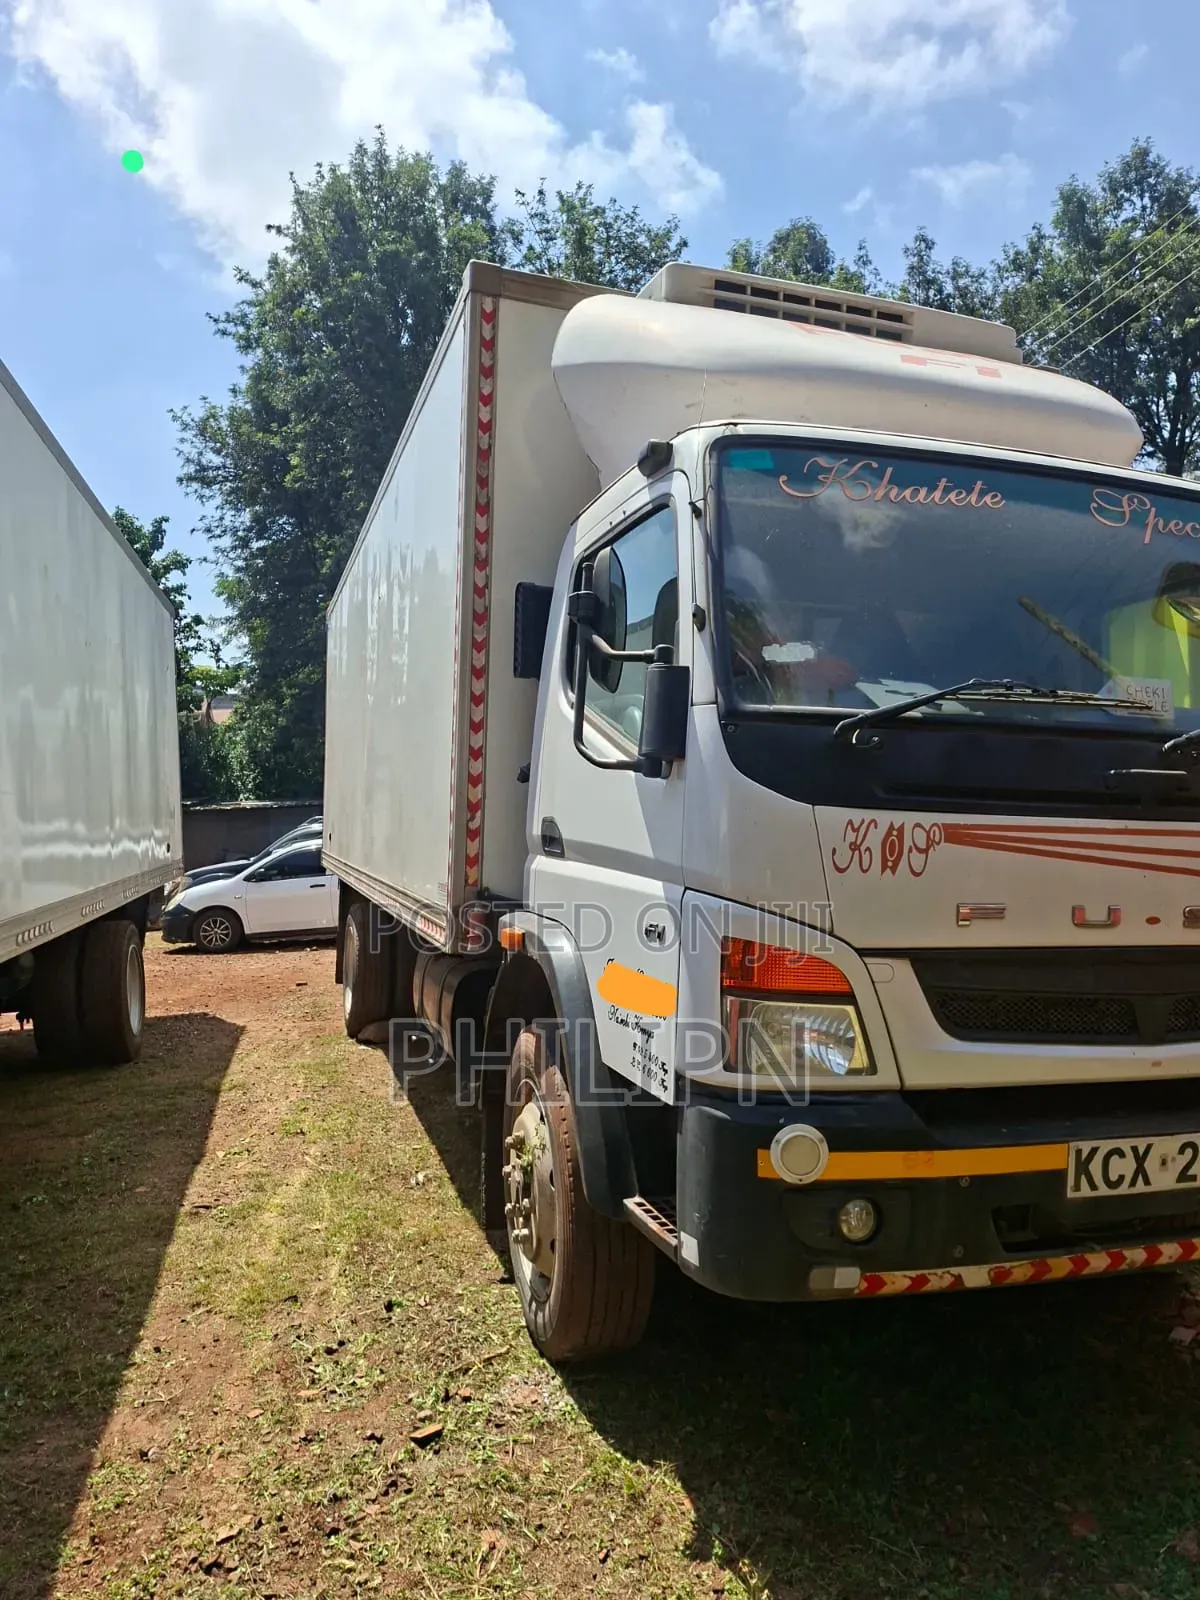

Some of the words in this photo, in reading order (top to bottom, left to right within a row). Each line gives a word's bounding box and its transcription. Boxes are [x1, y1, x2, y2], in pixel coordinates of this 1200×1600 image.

[778, 457, 1005, 509] Khatete
[1072, 1143, 1155, 1193] KCX
[1175, 1141, 1200, 1184] 2
